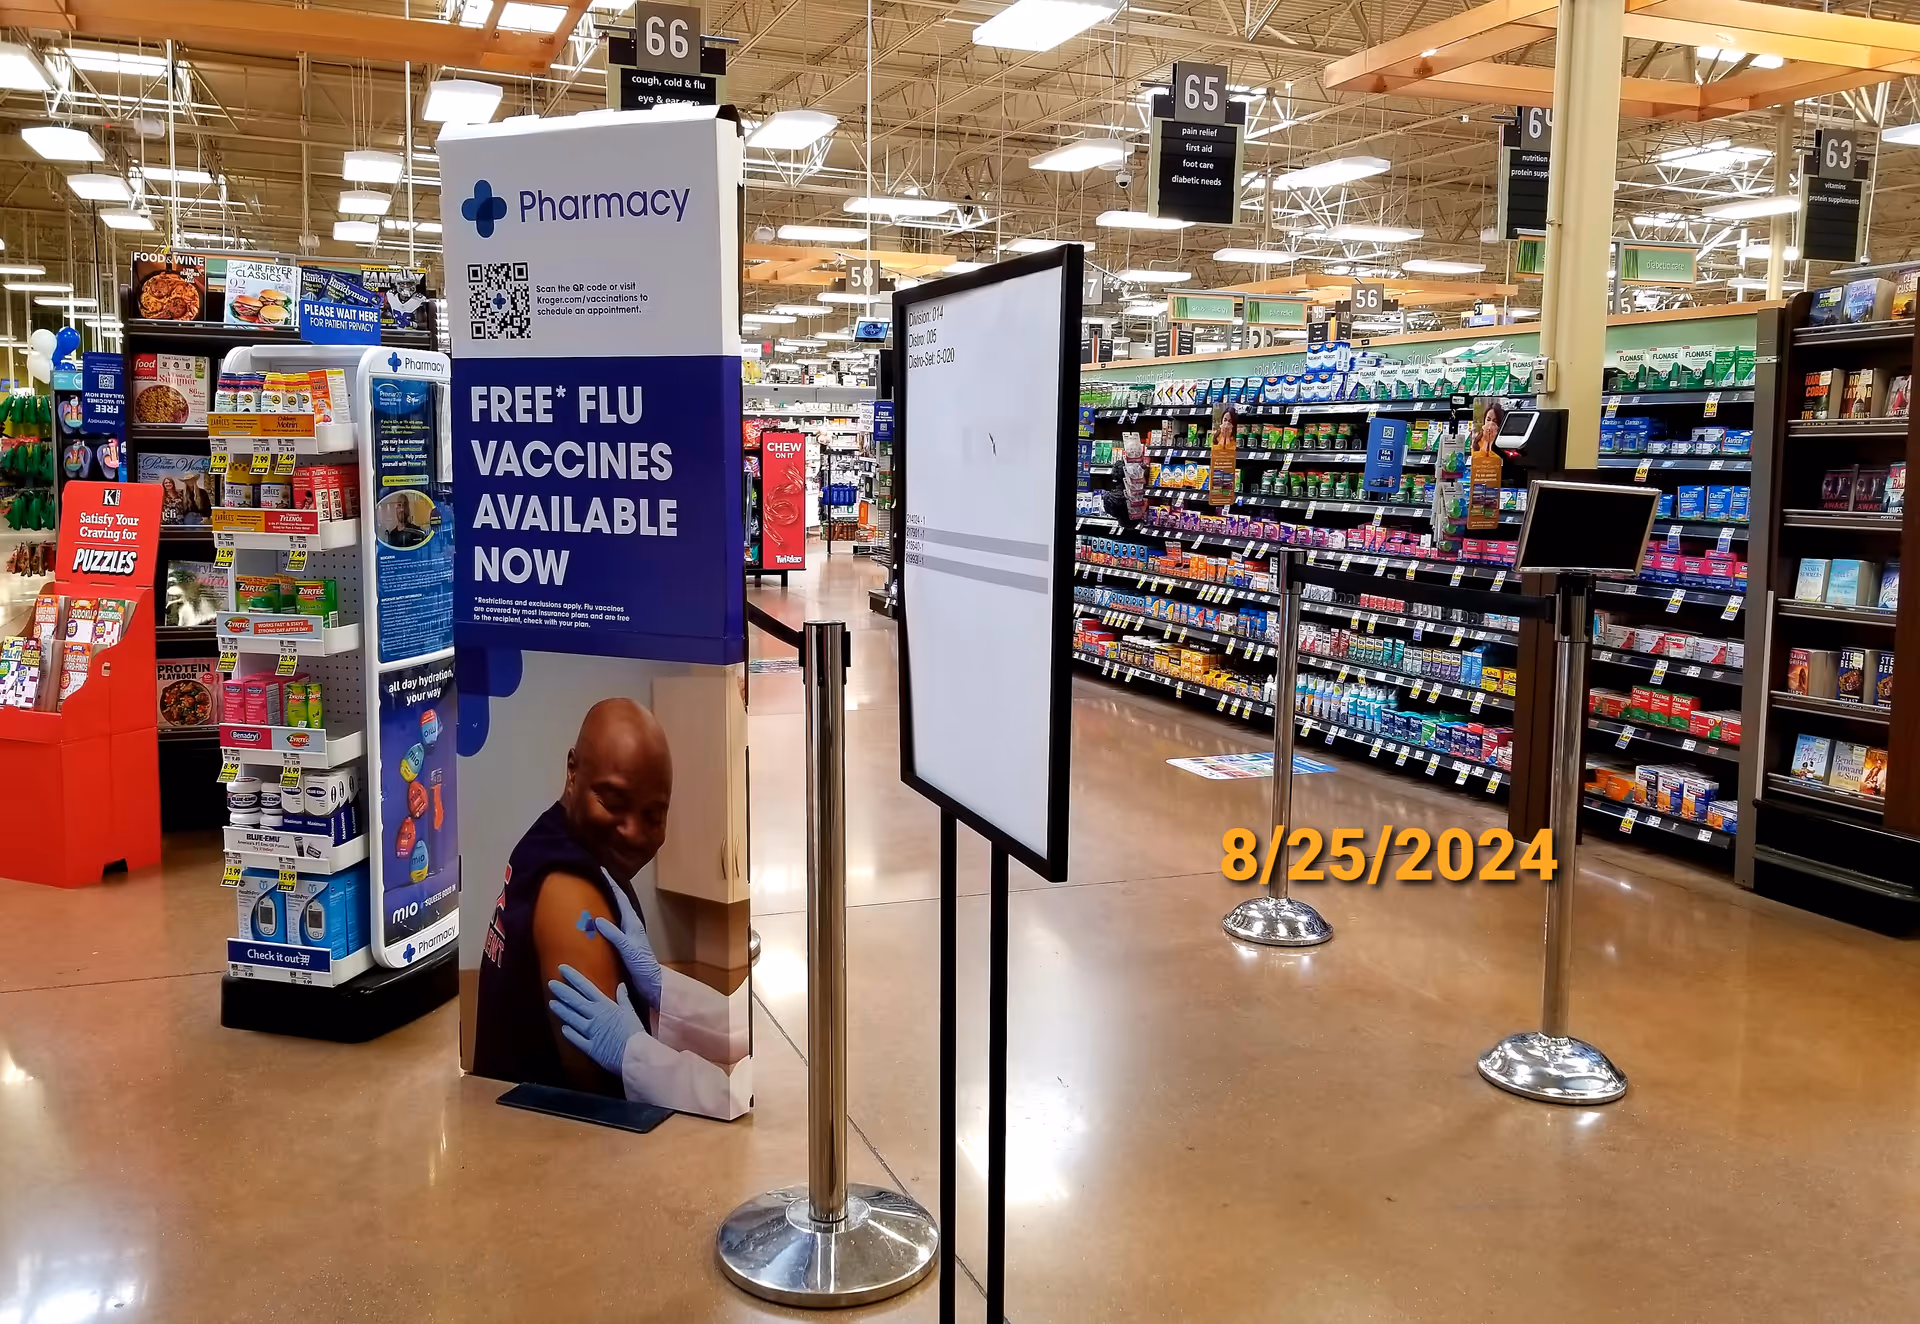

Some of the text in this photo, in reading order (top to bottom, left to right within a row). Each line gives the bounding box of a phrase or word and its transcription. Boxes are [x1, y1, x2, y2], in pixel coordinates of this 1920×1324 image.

[645, 15, 689, 59] 66
[631, 75, 706, 90] cough, cold & flu
[1184, 74, 1219, 111] 65
[637, 94, 654, 105] eye
[656, 95, 664, 105] &
[1181, 126, 1218, 137] pain relief
[1185, 143, 1213, 153] first aid
[1825, 138, 1852, 169] 63
[1182, 159, 1214, 170] foot care
[1171, 174, 1222, 186] diabetic needs
[1824, 182, 1847, 191] vitamins
[519, 188, 690, 223] Pharmacy
[1808, 194, 1860, 206] protein supplements
[247, 263, 293, 276] AIR FRYER
[235, 269, 282, 283] CLASSICS
[850, 266, 874, 287] 58
[536, 284, 556, 293] Scan
[557, 284, 570, 292] the
[572, 283, 585, 292] QR
[586, 283, 607, 291] code
[619, 282, 636, 290] visit
[536, 293, 649, 306] Kroger.com/vaccinations to
[1355, 289, 1378, 308] 56
[304, 303, 378, 323] PLEASE WAIT HERE
[537, 305, 642, 316] schedule an appointment.
[309, 317, 374, 333] FOR PATIENT PRIVACY
[1619, 354, 1644, 362] FLONASE
[1652, 352, 1678, 360] FLONASE
[1685, 350, 1712, 358] FLONASE
[134, 358, 156, 370] food
[404, 358, 445, 374] Pharmacy
[1155, 369, 1175, 382] relief
[1805, 385, 1829, 397] COBEN
[578, 386, 643, 424] FLU
[1801, 410, 1814, 420] THE
[1724, 436, 1743, 445] Claritin
[766, 442, 802, 452] CHEW
[213, 455, 227, 464] 7.99
[254, 455, 269, 464] 7.99
[279, 454, 294, 462] 7.49
[470, 439, 673, 481] VACCINES
[1709, 492, 1726, 500] Claritin
[1823, 502, 1849, 510] AWAKE
[80, 512, 140, 527] Satisfy Your
[472, 493, 678, 537] AVAILABLE
[79, 526, 138, 542] Craving for
[218, 549, 234, 558] 12.99
[291, 550, 306, 558] 7.49
[72, 548, 137, 574] PUZZLES
[474, 546, 570, 586] NOW
[239, 583, 268, 592] ZYRTEC
[298, 587, 325, 595] ZYRTEC
[528, 600, 562, 609] exclusions
[562, 602, 583, 611] apply.
[594, 604, 624, 613] vaccines
[485, 605, 511, 614] covered
[512, 608, 521, 617] by
[521, 608, 537, 616] most
[538, 610, 570, 618] insurance
[571, 611, 589, 621] plans
[616, 614, 630, 622] free
[481, 614, 492, 622] the
[492, 615, 522, 624] recipient,
[523, 617, 543, 625] check
[544, 618, 558, 626] with
[559, 620, 573, 628] your
[574, 621, 591, 629] plan.
[221, 651, 238, 659] 20.99
[280, 655, 297, 663] 20.99
[1791, 652, 1807, 661] LAURA
[1789, 658, 1808, 667] GRIFFIN
[157, 663, 211, 674] PROTEIN
[157, 672, 197, 681] PLAYBOOK
[388, 666, 454, 693] all day hydration,
[406, 687, 442, 706] your way
[1632, 687, 1650, 697] TYLENOL
[1651, 692, 1670, 701] TYLENOL
[1672, 695, 1692, 705] TYLENOL
[232, 731, 259, 740] Benadryl
[289, 735, 310, 743] ZYRTEC
[1835, 755, 1853, 765] Bend
[284, 767, 300, 775] 14.99
[1836, 763, 1864, 776] Toward
[246, 833, 281, 843] BLUE-EMU
[225, 867, 241, 876] 13.99
[280, 872, 296, 881] 15.99
[418, 924, 456, 954] Pharmacy
[247, 948, 300, 964] Check it out
